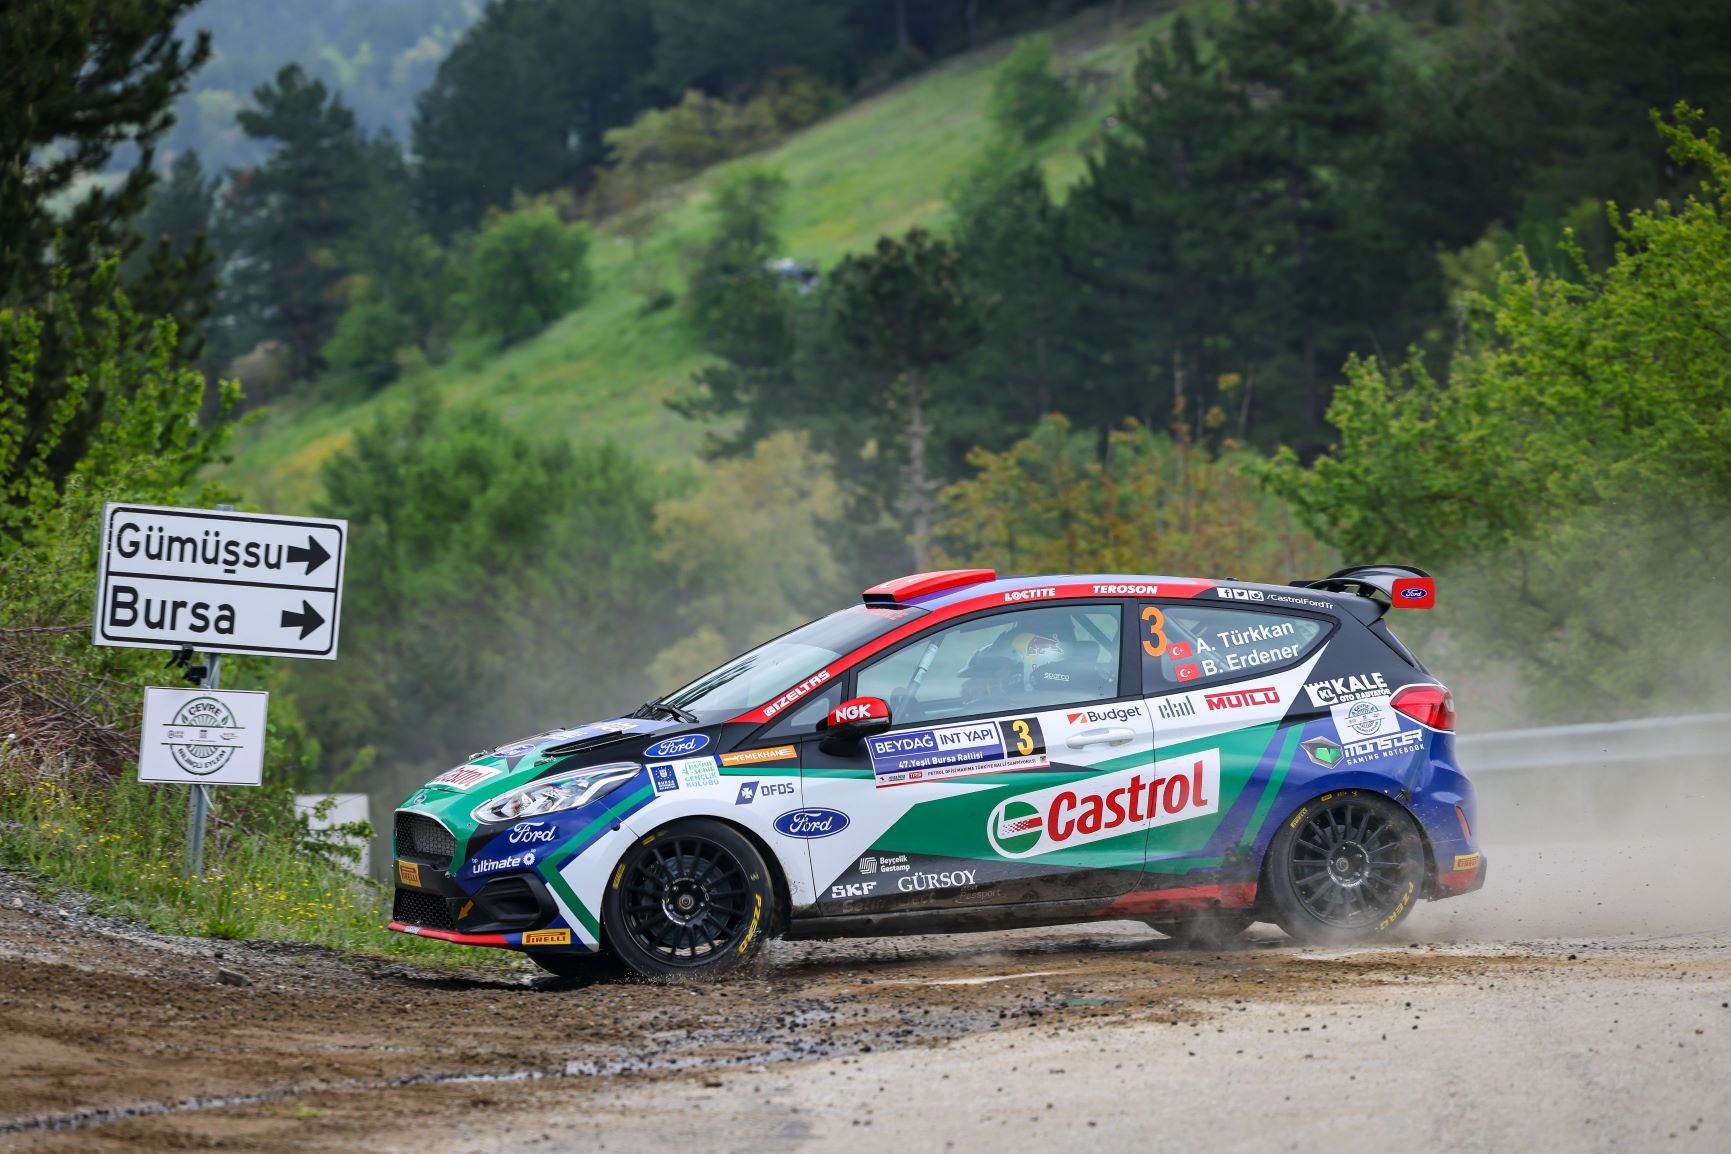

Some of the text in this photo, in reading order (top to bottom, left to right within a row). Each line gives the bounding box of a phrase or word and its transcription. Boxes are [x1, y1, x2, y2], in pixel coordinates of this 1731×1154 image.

[117, 522, 283, 574] Gümüşsu
[1004, 587, 1056, 602] LOCTITE
[1093, 585, 1158, 595] TEROSON
[109, 585, 236, 635] Bursa
[1141, 606, 1168, 657] 3
[1196, 622, 1295, 654] A. Türkkan
[1202, 643, 1300, 676] B. Erdener
[1330, 672, 1388, 695] KALE
[1204, 686, 1281, 711] MUTLU
[1340, 694, 1355, 703] OTO
[835, 703, 873, 723] NGK
[1087, 705, 1141, 723] Budget
[657, 738, 697, 755] Ford
[875, 733, 934, 754] BEYDAĞ
[964, 728, 995, 744] YAPI
[1012, 719, 1034, 756] 3
[1344, 729, 1423, 758] MONSTER
[932, 755, 956, 765] Bursa
[957, 751, 983, 762] Rallisi
[1347, 743, 1425, 766] GAMING NOTEBOOK
[761, 782, 795, 797] DFDS
[1047, 760, 1208, 842] Castrol
[509, 821, 557, 844] Ford
[789, 812, 833, 834] Ford
[473, 856, 521, 874] ultimate
[880, 854, 908, 866] Beyçelik
[880, 863, 911, 873] Gestamp
[831, 881, 877, 898] SKF
[898, 869, 976, 892] GÜRSOY
[526, 932, 566, 944] PIRELLI
